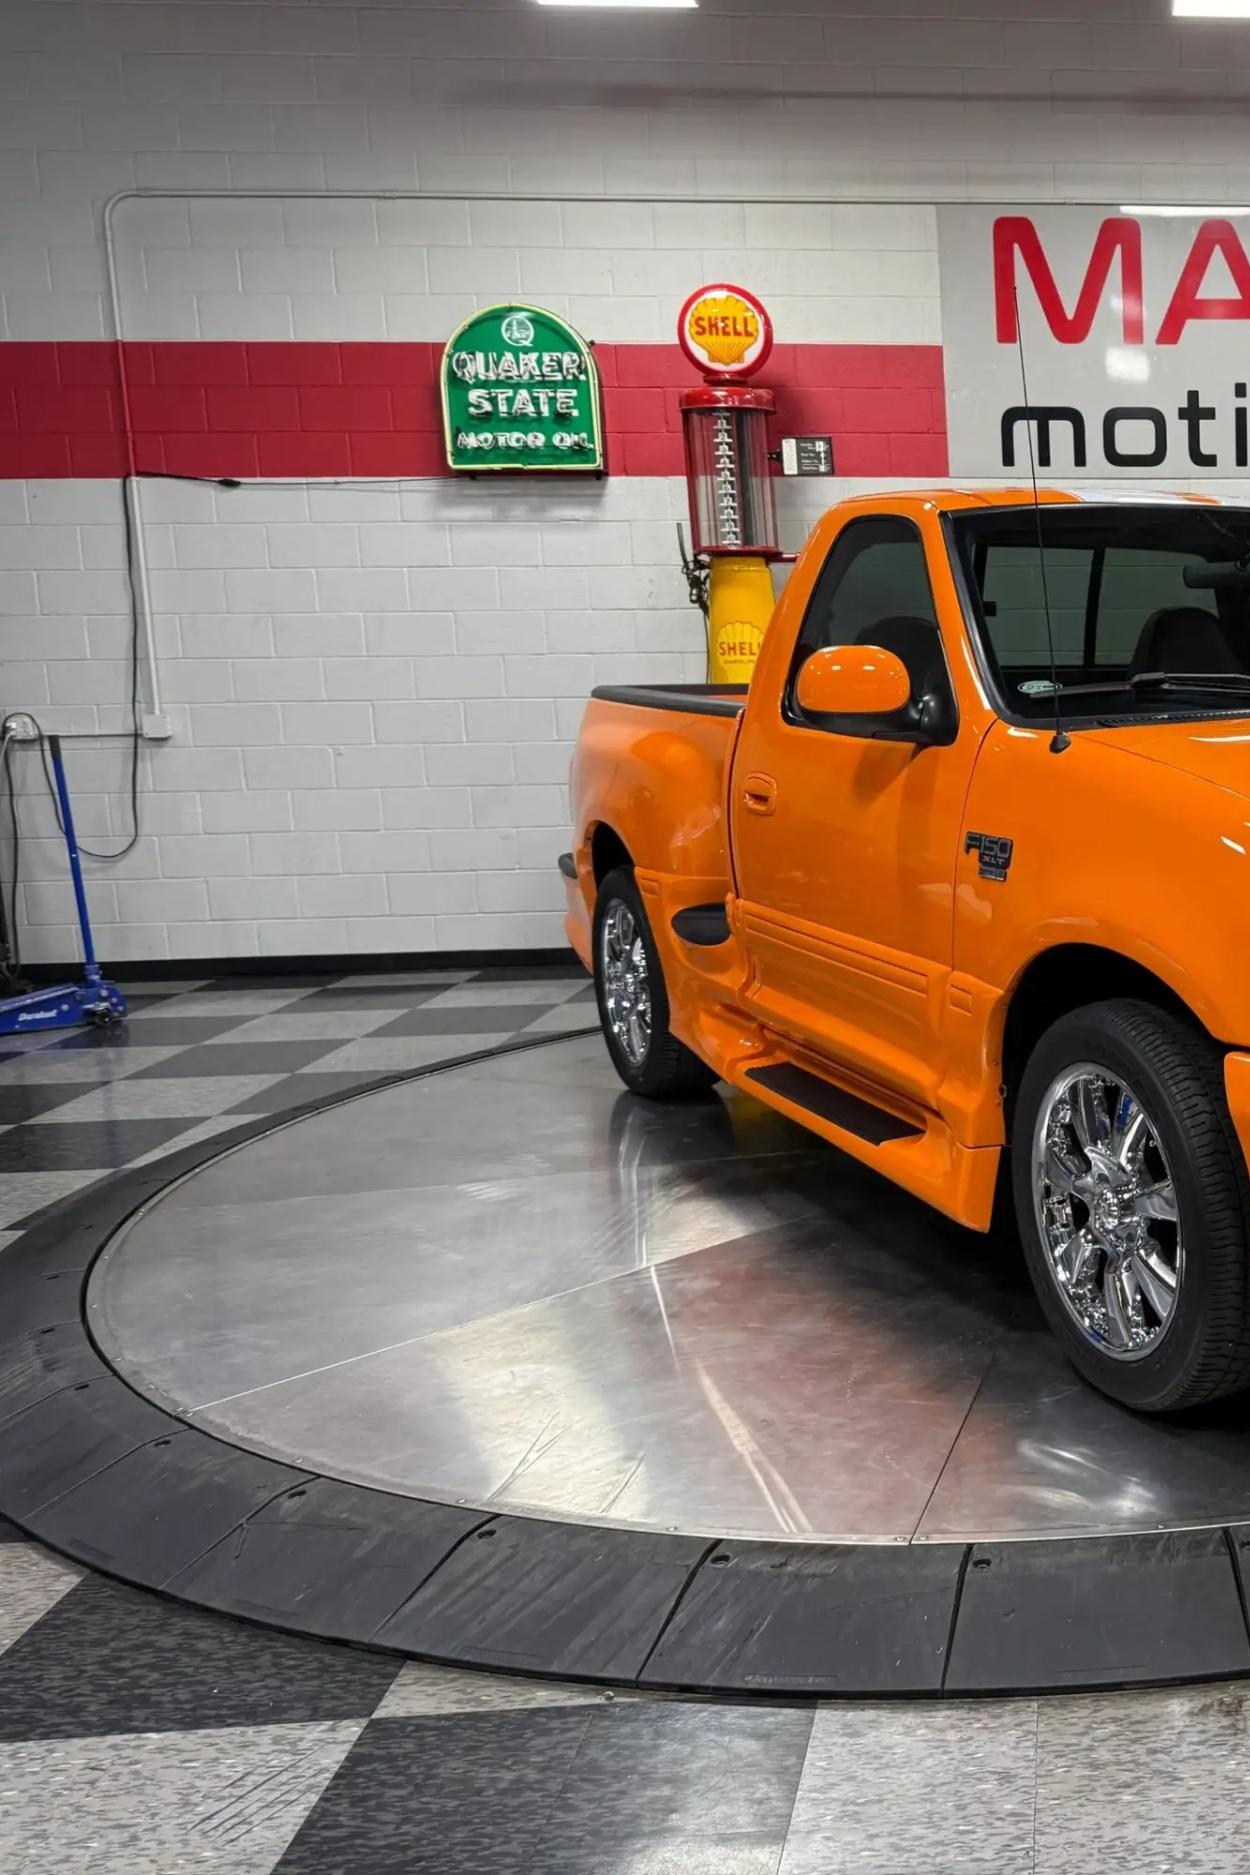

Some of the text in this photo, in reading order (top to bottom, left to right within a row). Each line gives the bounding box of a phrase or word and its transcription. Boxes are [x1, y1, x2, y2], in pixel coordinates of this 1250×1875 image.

[694, 315, 754, 337] SHELL
[452, 351, 587, 384] QUAKER
[467, 388, 579, 417] STATE
[456, 431, 594, 450] MOTOR OIL
